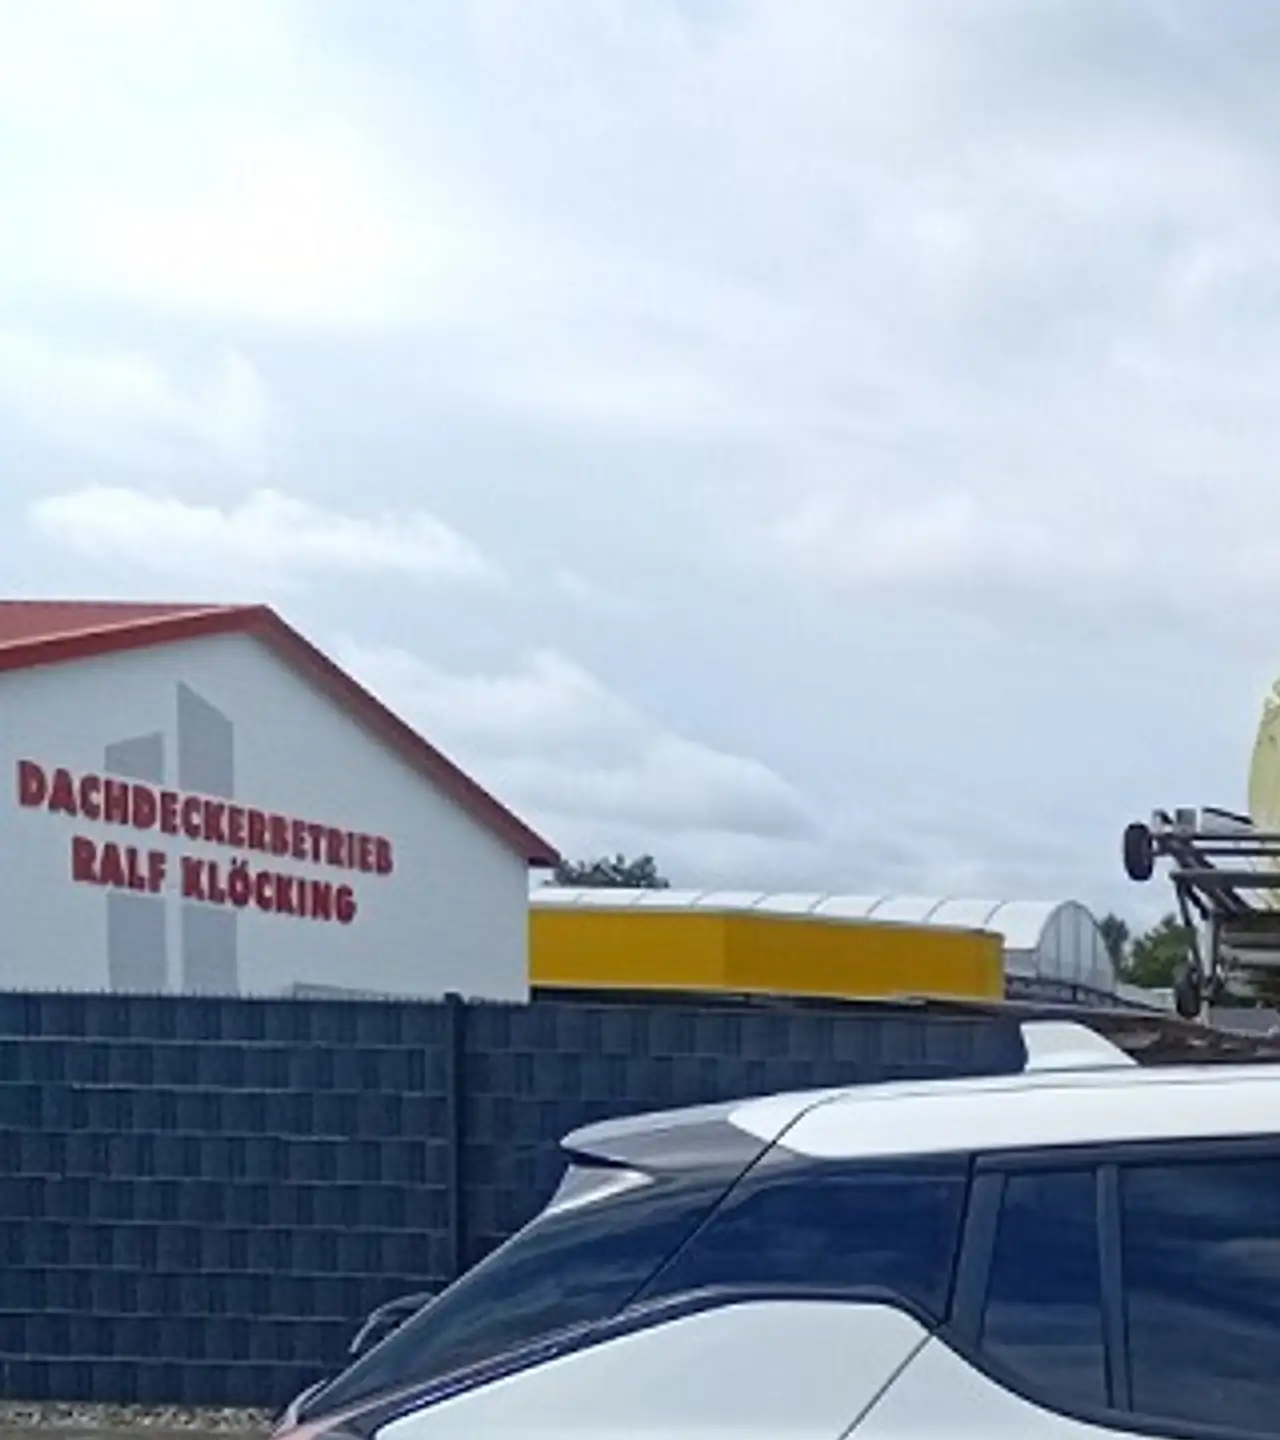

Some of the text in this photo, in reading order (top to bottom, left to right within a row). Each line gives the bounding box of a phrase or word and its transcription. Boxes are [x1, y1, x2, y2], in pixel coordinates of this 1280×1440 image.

[17, 759, 394, 876] DACHDECKERBETRIEB
[71, 835, 358, 926] RALF KLÖCKING
